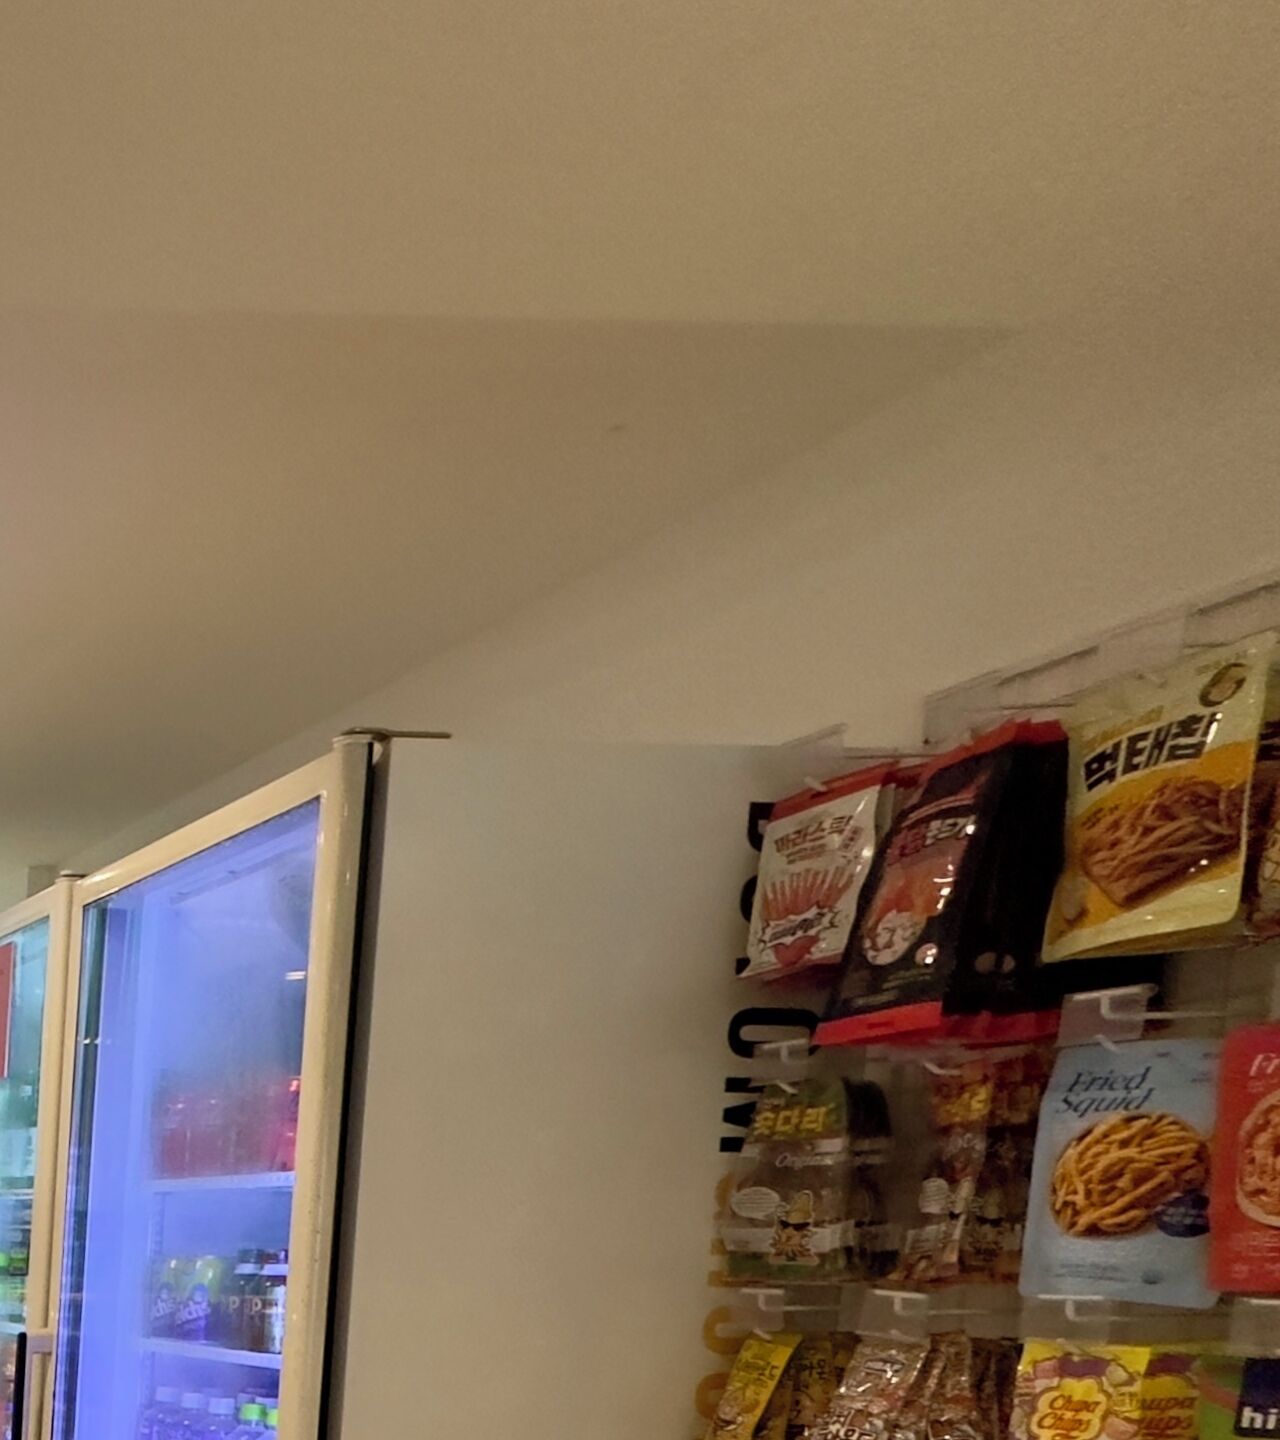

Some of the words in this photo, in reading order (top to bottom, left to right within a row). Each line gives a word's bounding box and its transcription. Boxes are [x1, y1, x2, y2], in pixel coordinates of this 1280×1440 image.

[1067, 1065, 1153, 1093] Fried
[1056, 1088, 1156, 1118] Squid
[1048, 1393, 1102, 1417] Chupa
[1036, 1412, 1093, 1434] Chups
